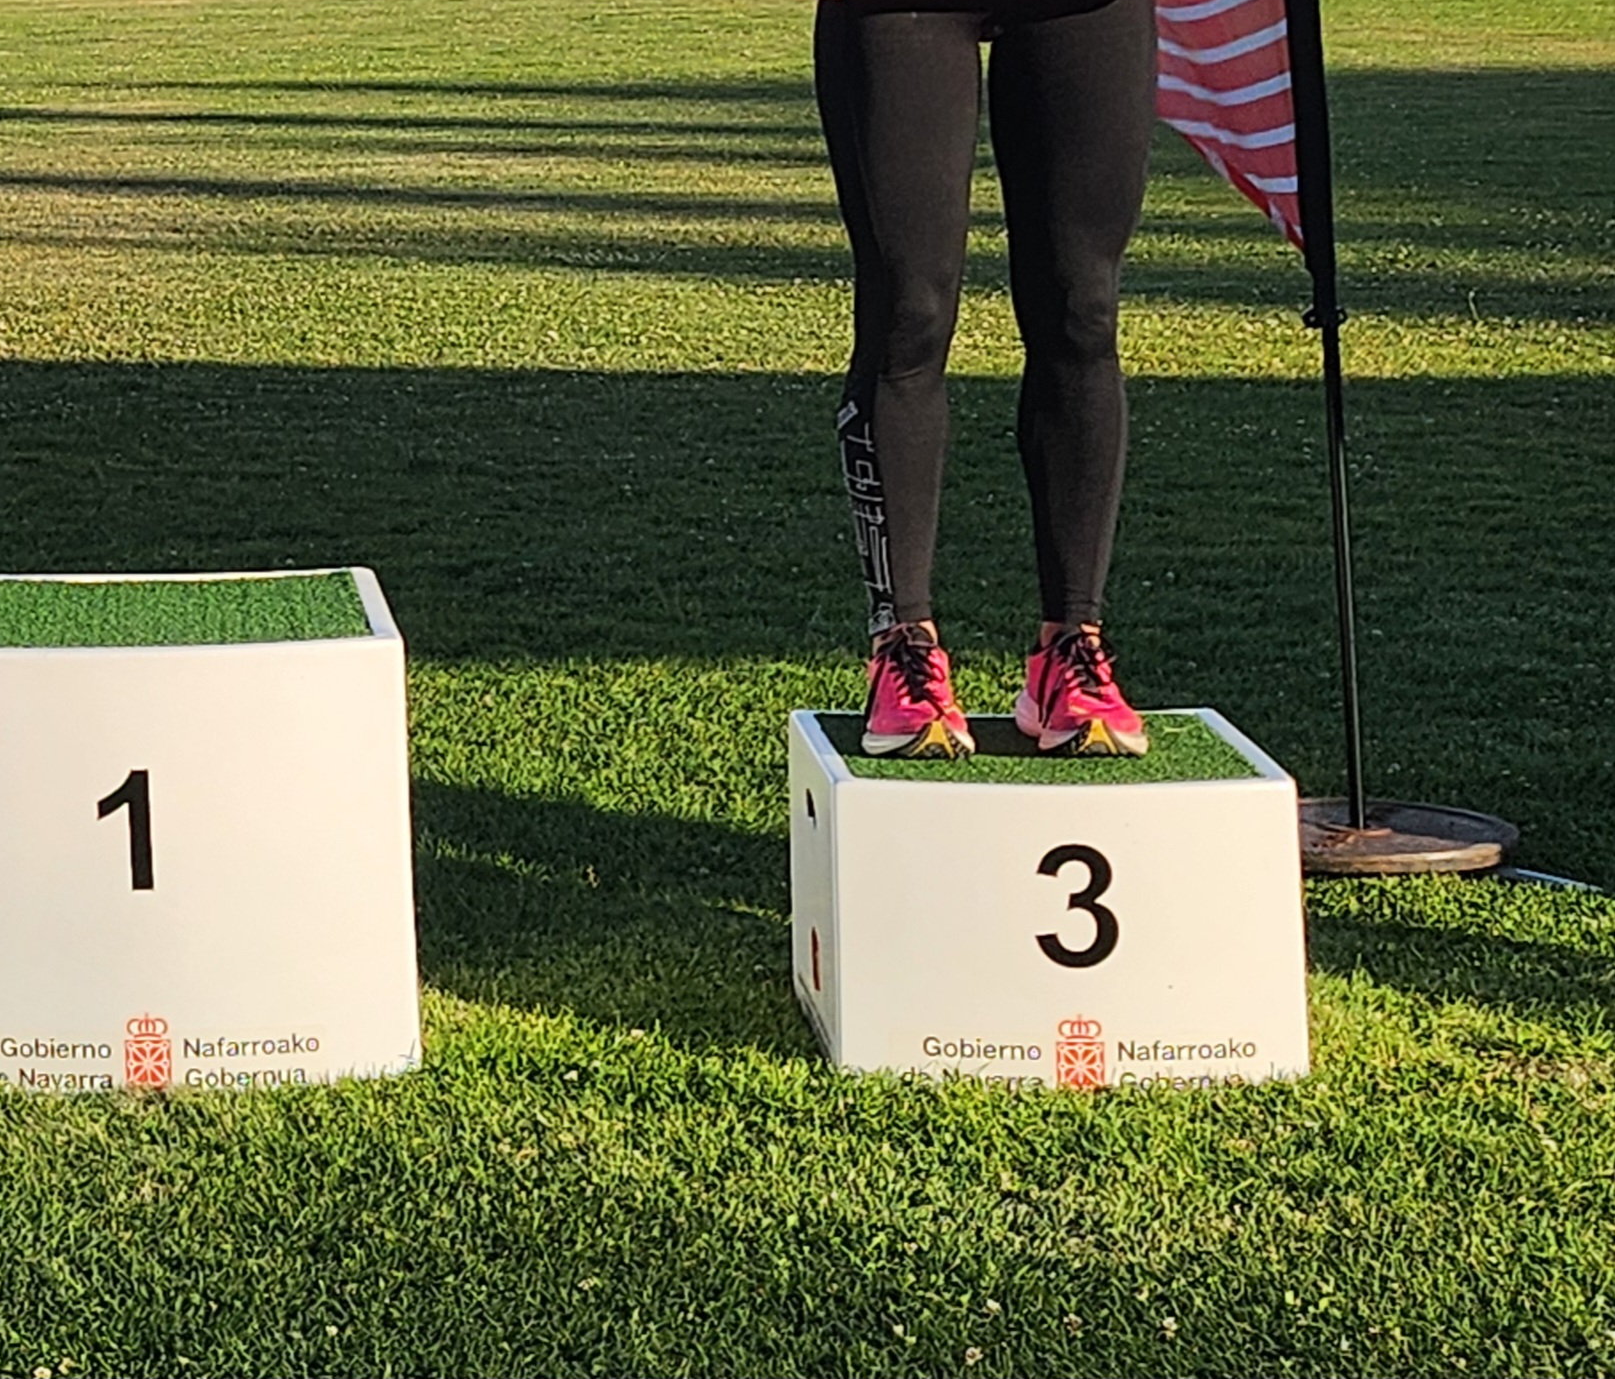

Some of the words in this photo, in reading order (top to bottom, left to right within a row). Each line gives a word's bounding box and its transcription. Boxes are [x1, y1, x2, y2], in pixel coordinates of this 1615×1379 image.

[97, 769, 155, 891] 1
[1035, 843, 1120, 969] 3
[0, 1037, 112, 1059] Gobierno
[183, 1033, 320, 1058] Nafarroako
[923, 1036, 1042, 1060] Gobierno
[1117, 1038, 1257, 1062] Nafarroako
[19, 1067, 113, 1091] Navarra
[185, 1067, 307, 1089] Gobernua
